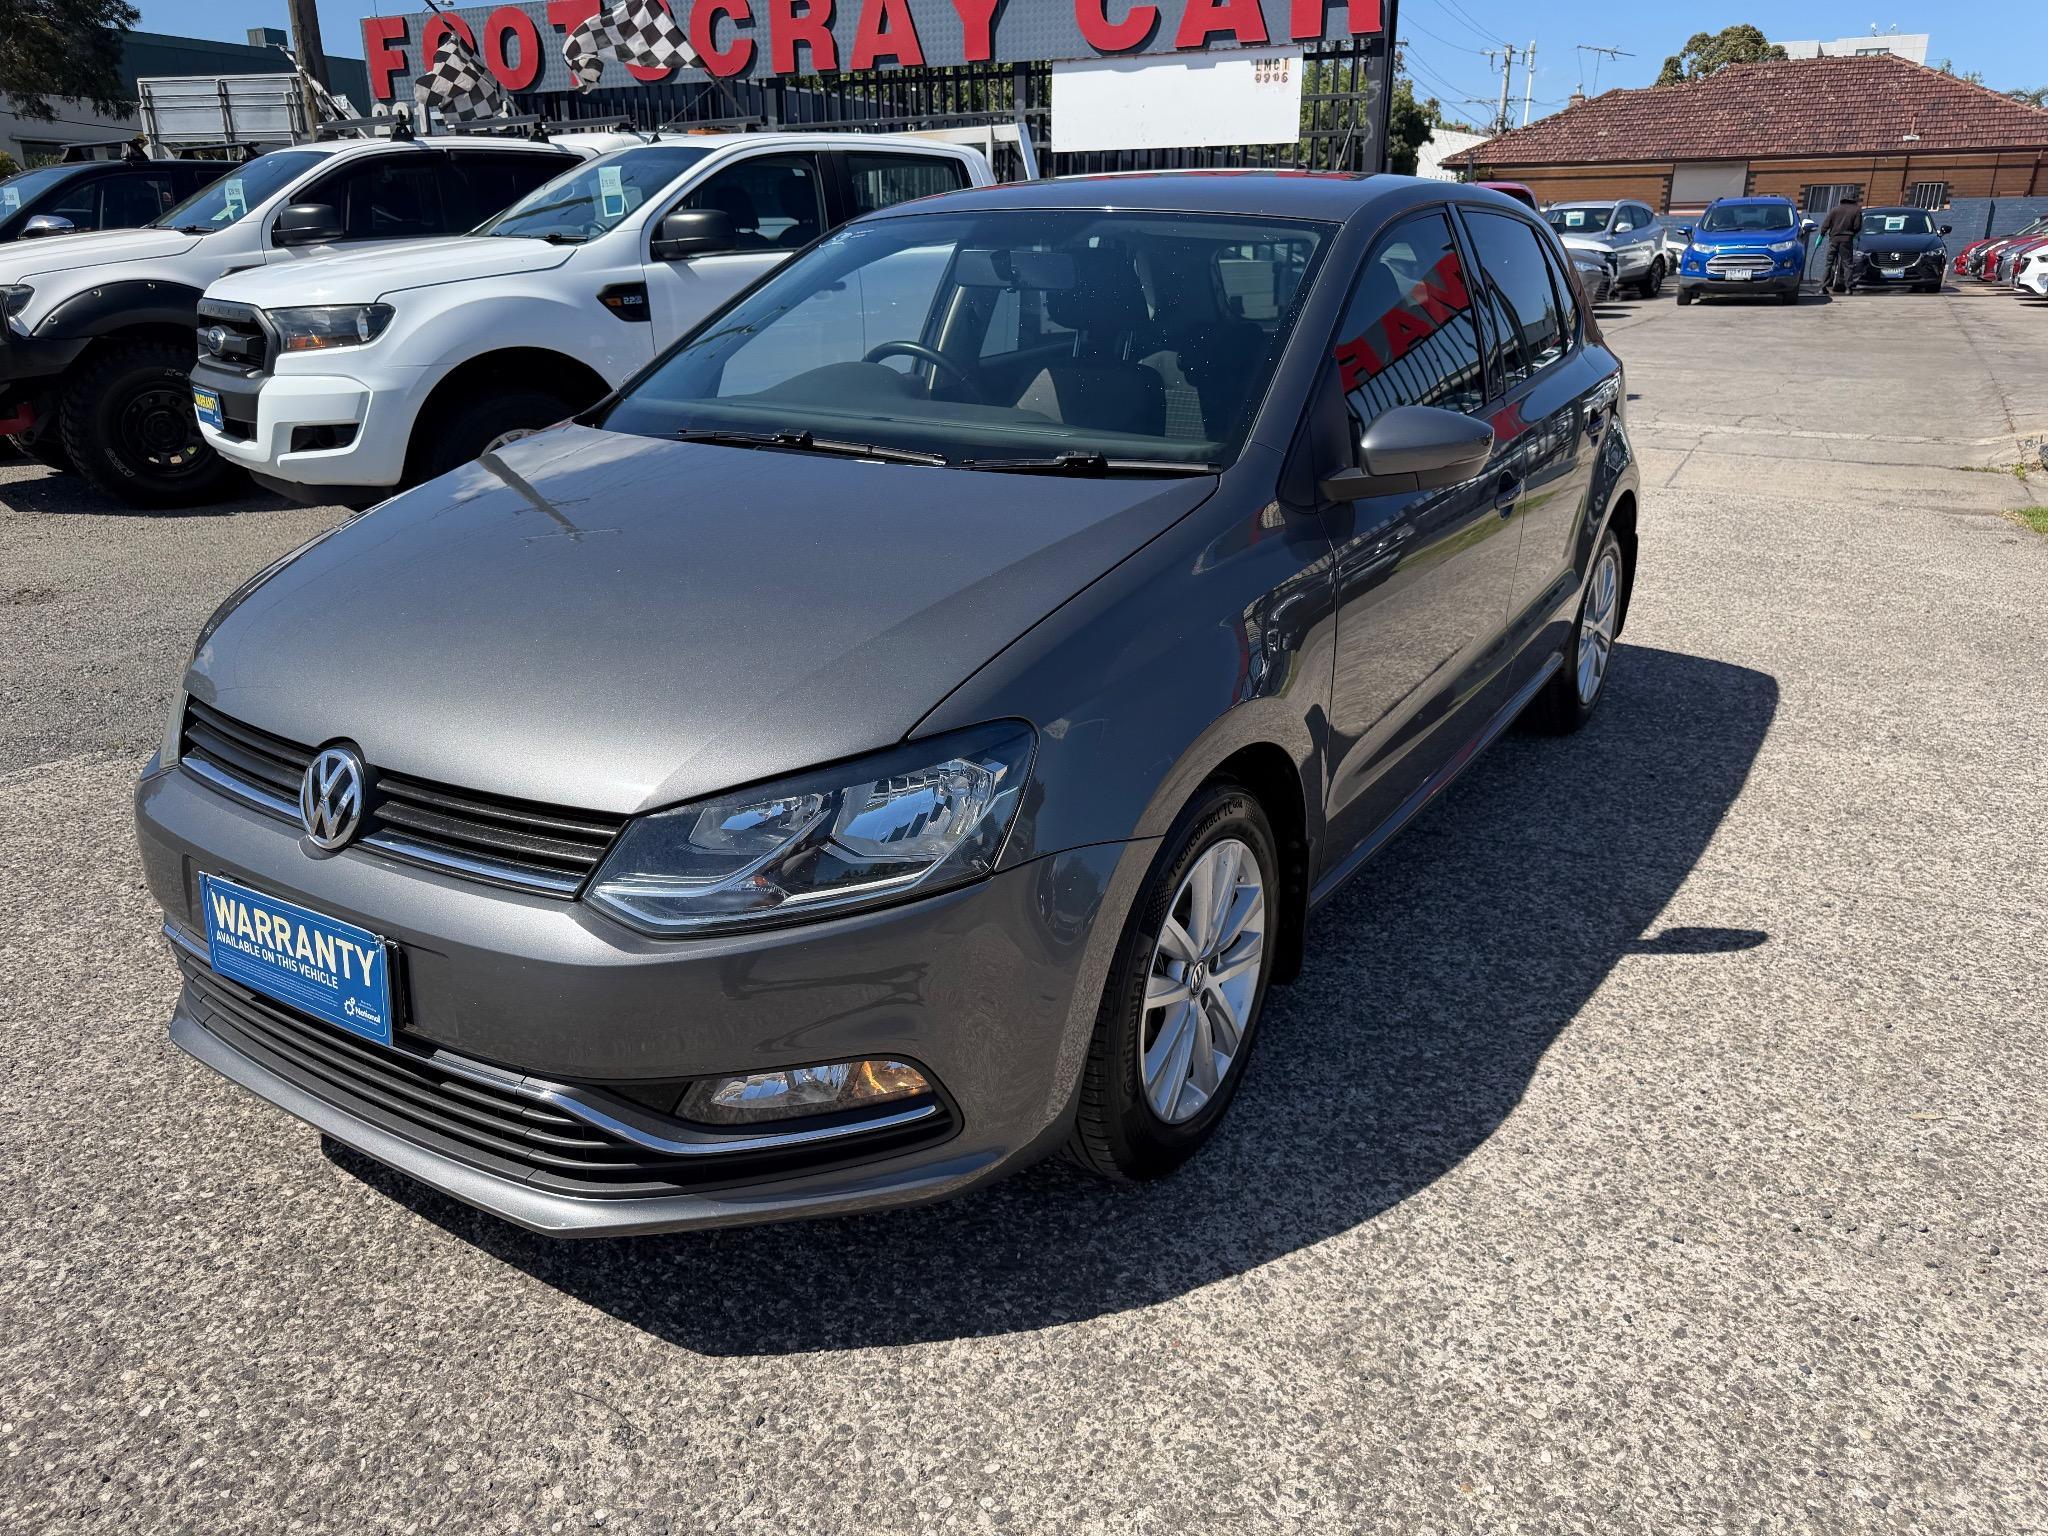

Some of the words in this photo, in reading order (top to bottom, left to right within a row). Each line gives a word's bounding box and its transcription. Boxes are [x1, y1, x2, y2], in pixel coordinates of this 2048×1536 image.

[1256, 58, 1289, 71] LMCT
[211, 890, 375, 987] WARRANTY
[216, 930, 260, 957] AVAILABLE
[261, 949, 275, 963] ON
[275, 954, 298, 972] THIS
[298, 962, 338, 989] VEHICLE
[354, 1006, 381, 1024] National
